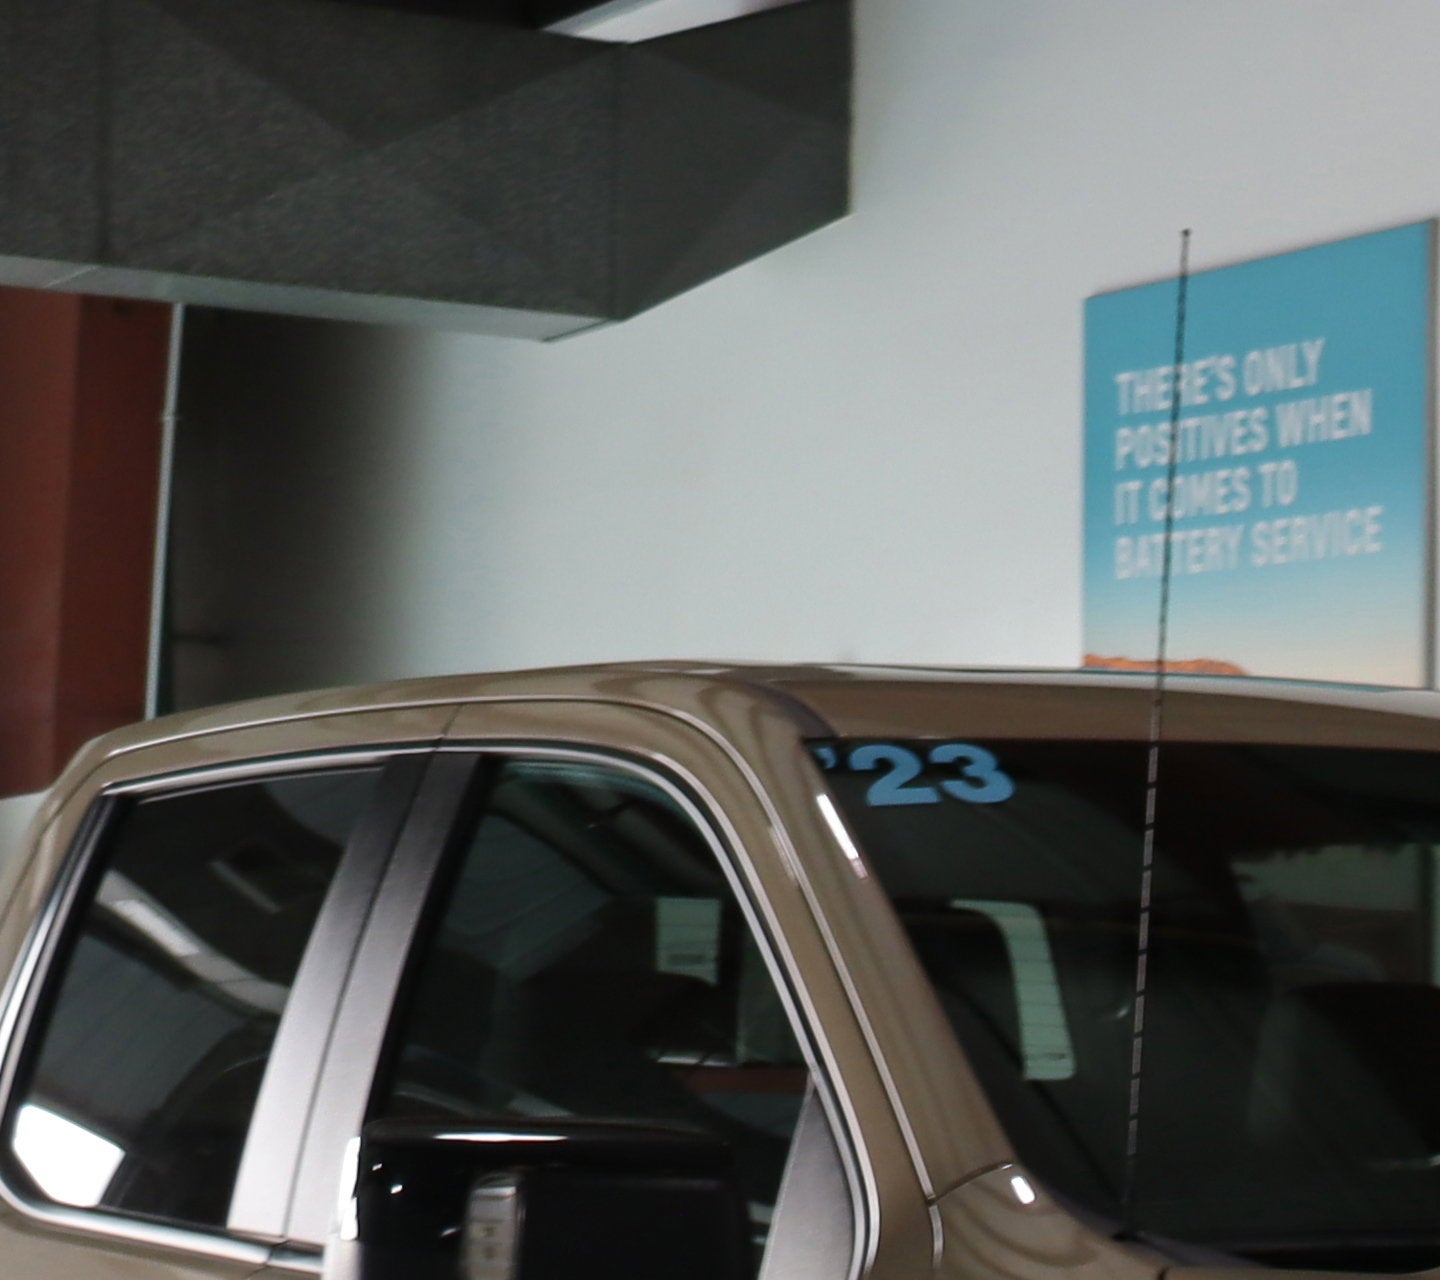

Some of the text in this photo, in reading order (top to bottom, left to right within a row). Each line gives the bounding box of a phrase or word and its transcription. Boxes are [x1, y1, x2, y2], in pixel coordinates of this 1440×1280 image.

[1113, 336, 1326, 416] THERE'S ONLY
[1114, 388, 1373, 472] POSITIVES WHEN
[1114, 458, 1299, 526] IT COMES TO
[1114, 504, 1386, 581] BATTERY SERVICE
